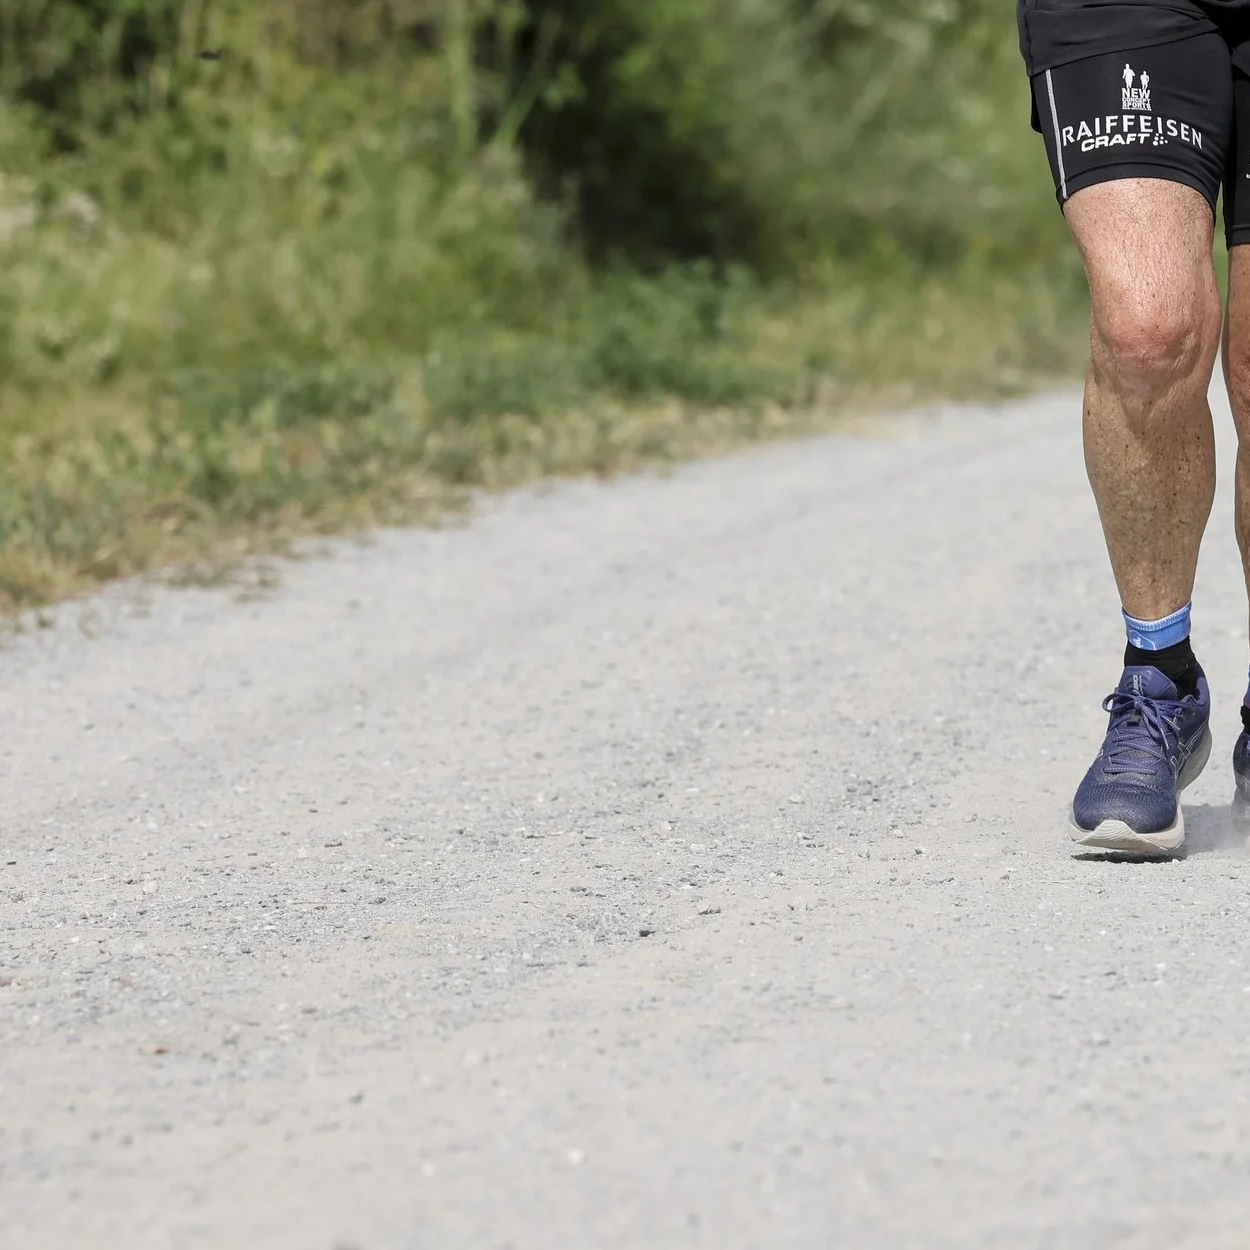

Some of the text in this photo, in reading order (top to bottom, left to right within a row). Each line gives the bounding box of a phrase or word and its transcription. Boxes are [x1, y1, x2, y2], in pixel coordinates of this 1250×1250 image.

[1121, 87, 1151, 99] NEW
[1122, 101, 1152, 109] SPORTS
[1062, 114, 1203, 150] RAIFFEISEN
[1081, 133, 1150, 152] CRAFT
